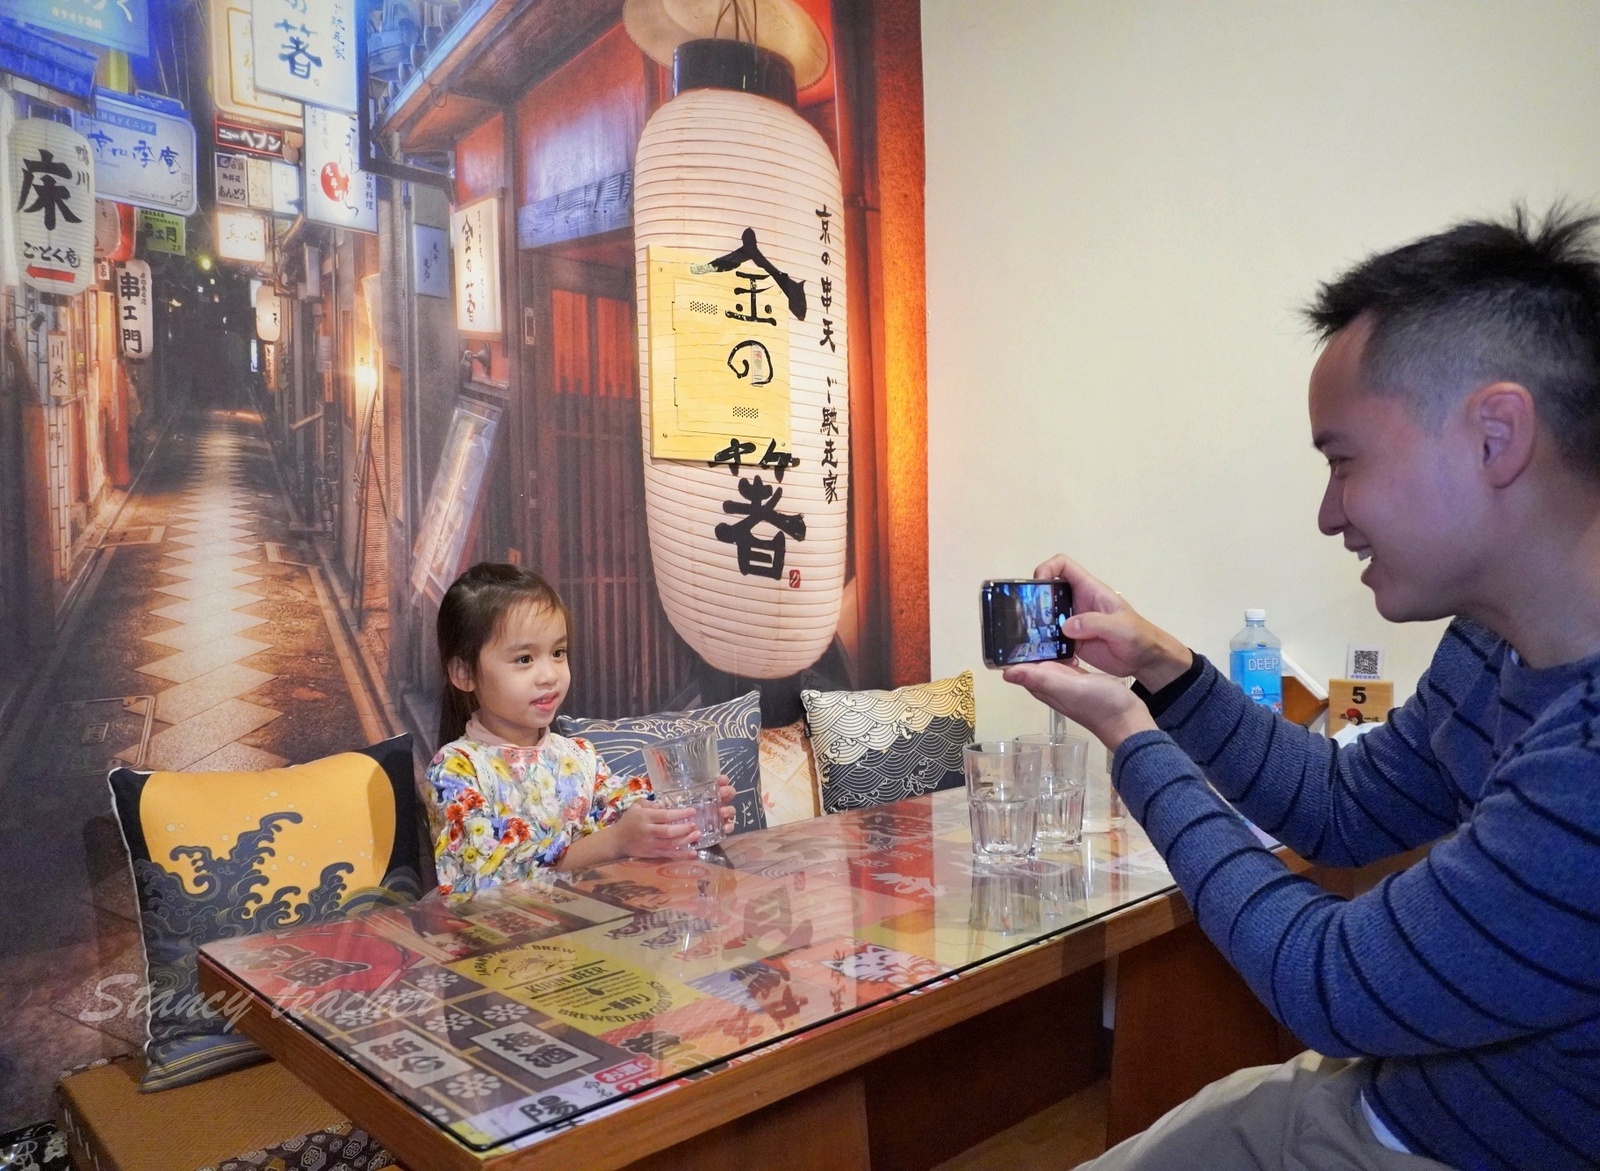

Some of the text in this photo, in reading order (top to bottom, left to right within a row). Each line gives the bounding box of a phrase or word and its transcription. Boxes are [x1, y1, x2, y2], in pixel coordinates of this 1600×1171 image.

[16, 149, 82, 231] 床
[1248, 657, 1280, 672] DEEP
[1352, 686, 1367, 704] 5
[567, 966, 609, 981] BEER
[558, 1008, 626, 1023] BREWED
